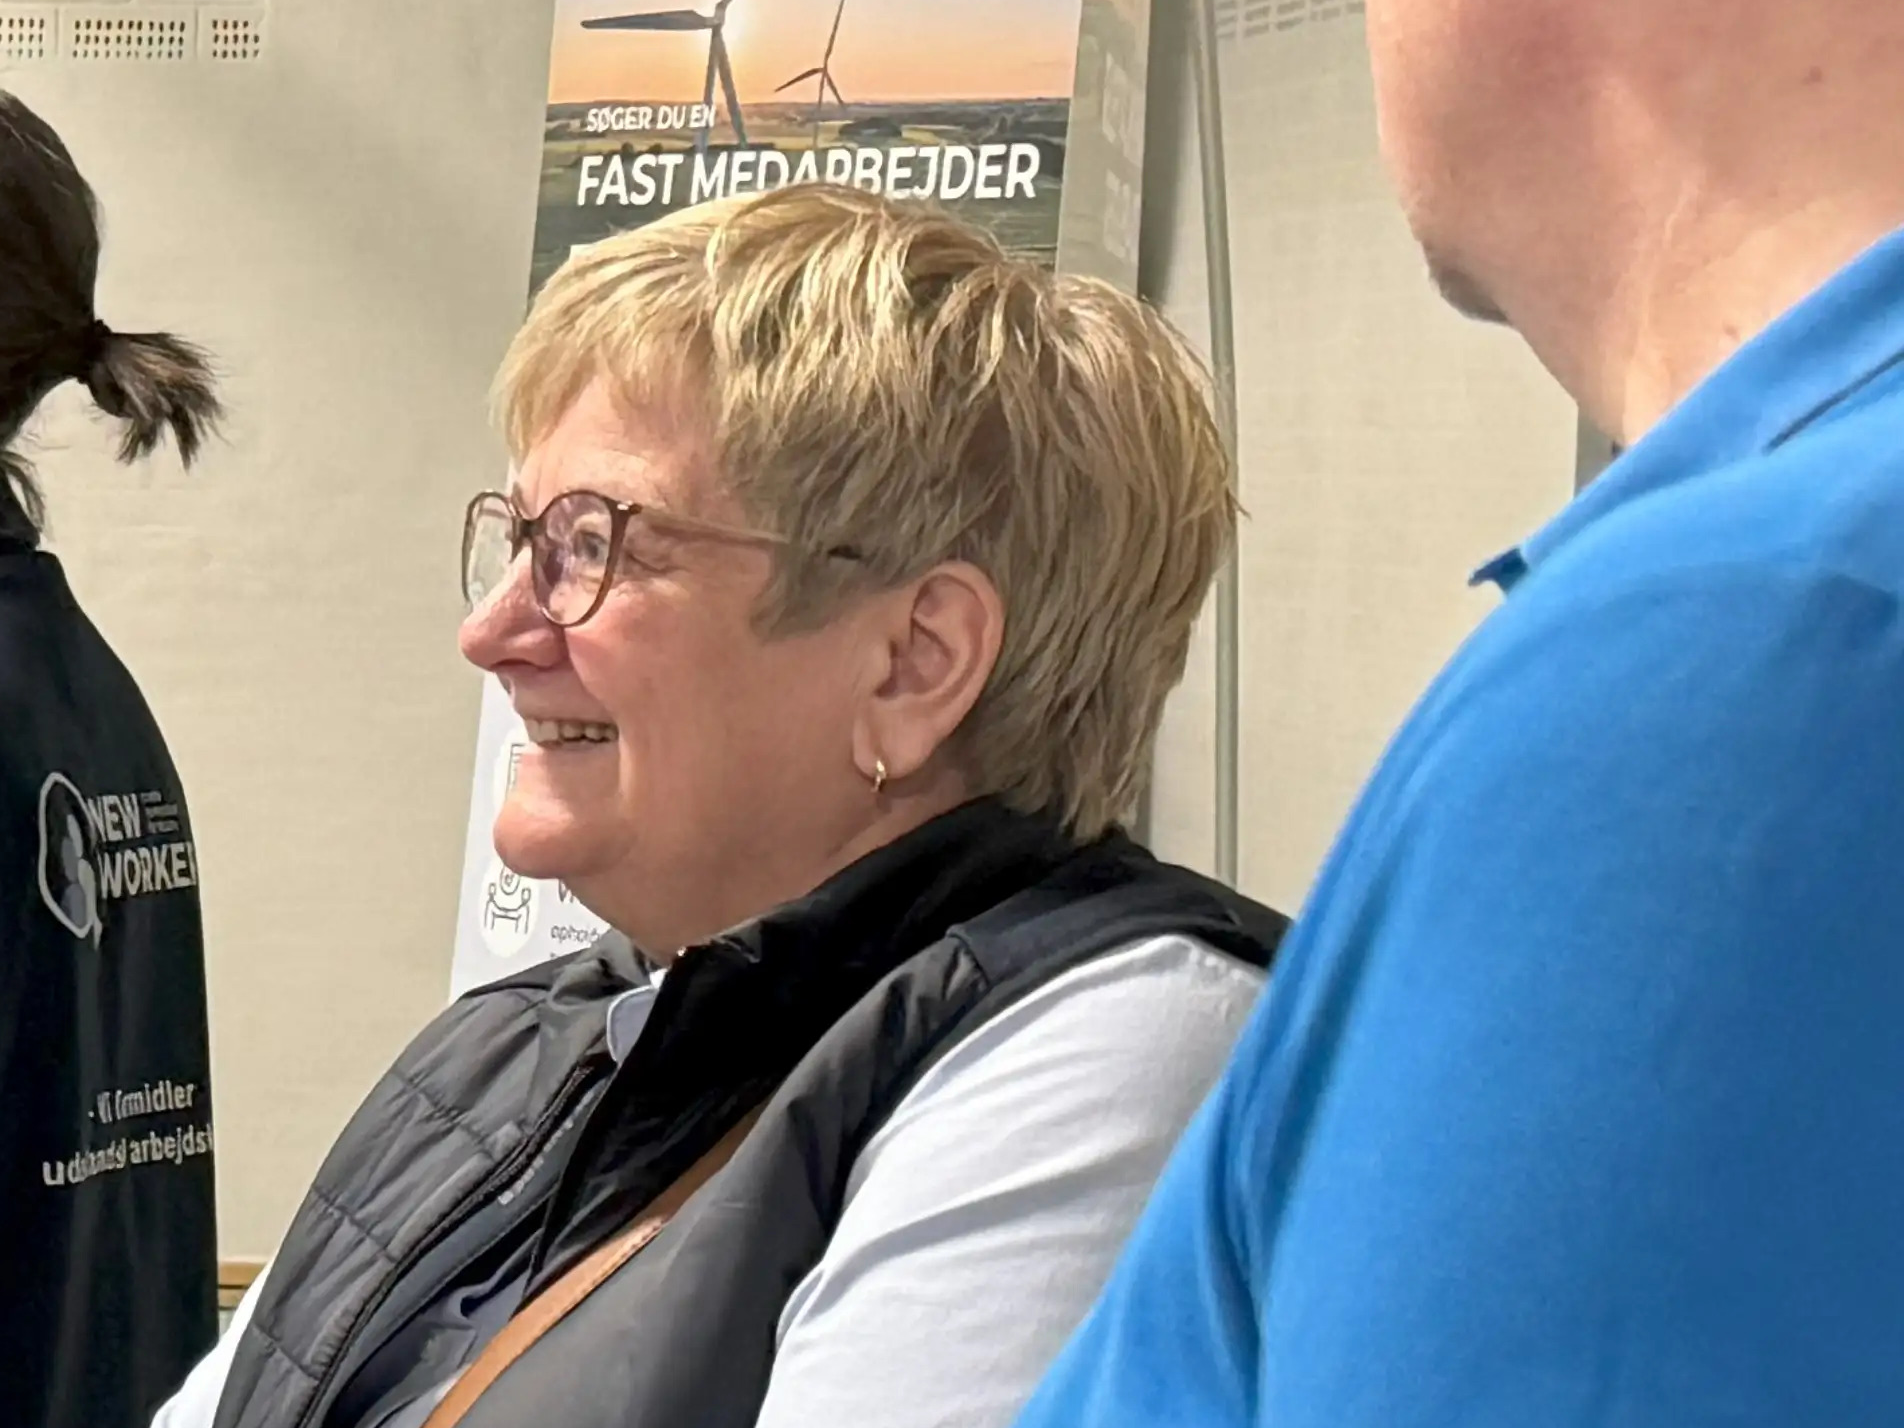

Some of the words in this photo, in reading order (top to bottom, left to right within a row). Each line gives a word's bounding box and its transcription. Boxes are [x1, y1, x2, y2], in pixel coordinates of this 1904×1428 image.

[586, 106, 650, 133] SØGER
[656, 107, 684, 130] DU
[690, 104, 715, 128] EN
[577, 154, 684, 206] FAST
[691, 143, 1041, 203] MEDARBEJDER
[87, 793, 142, 843] NEW
